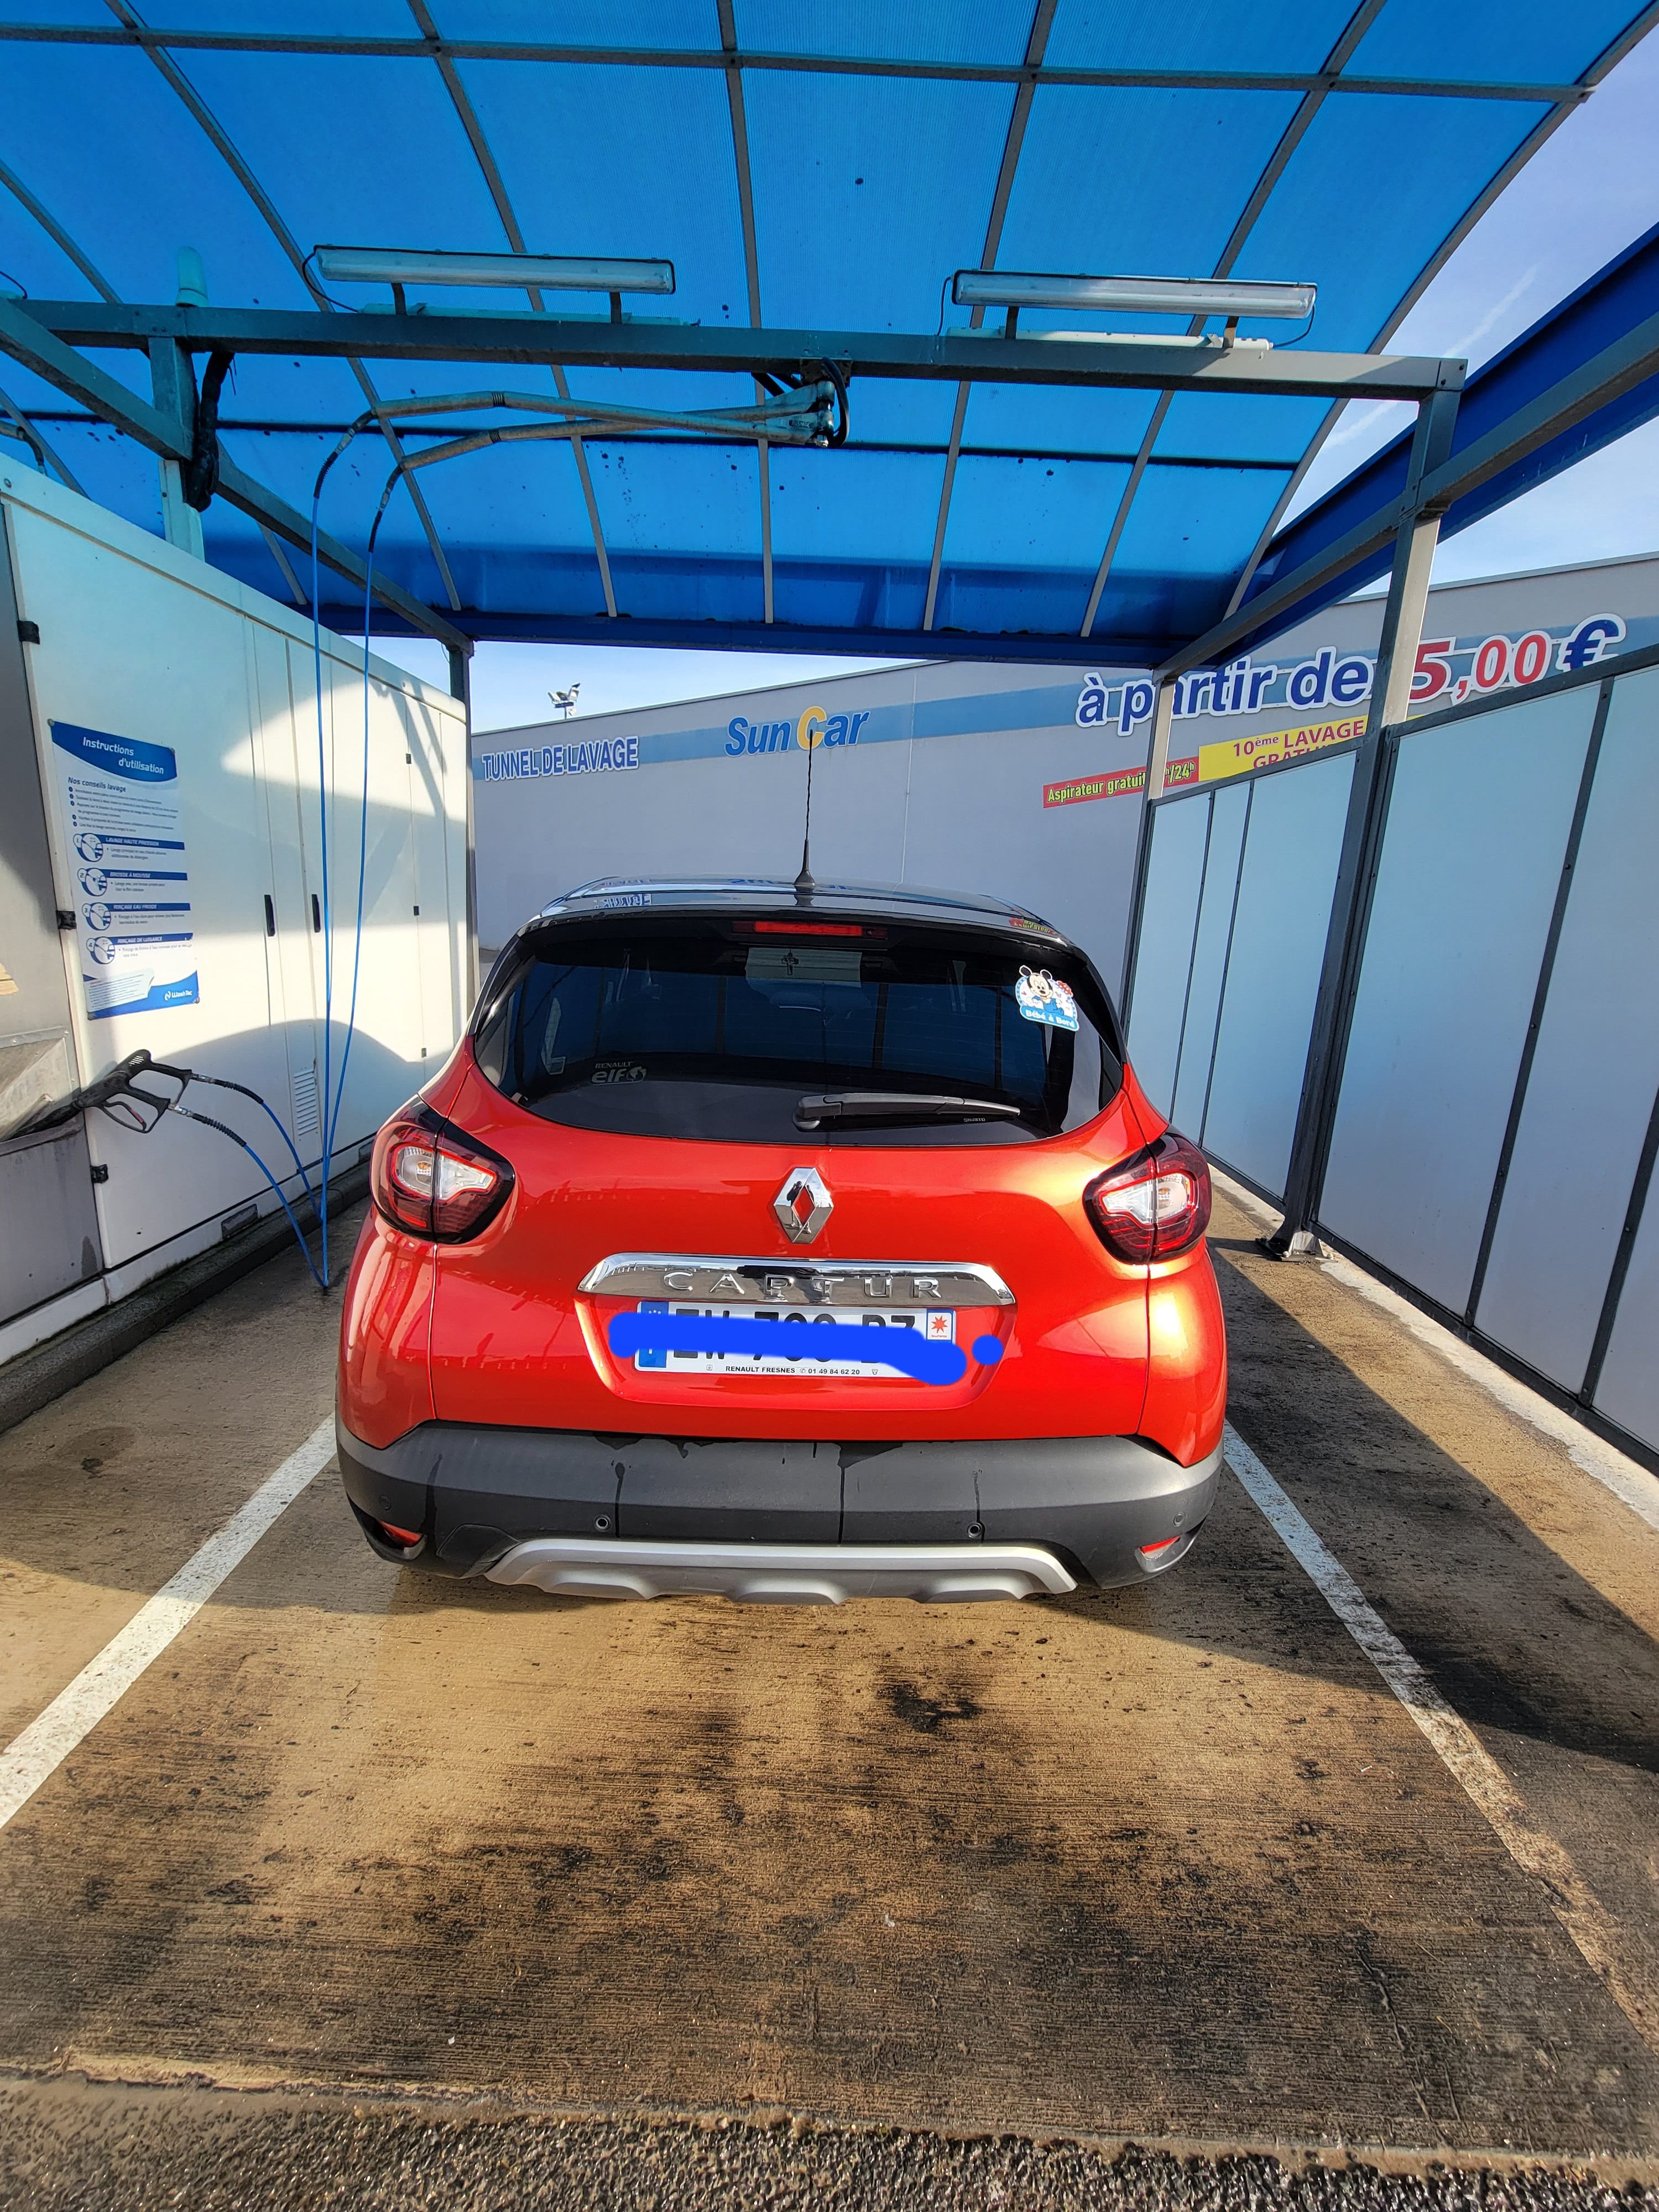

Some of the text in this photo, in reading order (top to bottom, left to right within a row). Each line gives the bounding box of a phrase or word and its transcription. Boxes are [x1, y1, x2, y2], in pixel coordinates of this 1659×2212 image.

[1081, 676, 1105, 723] à
[1291, 652, 1369, 706] de
[1408, 634, 1547, 700] 5,00
[1564, 619, 1619, 671] €
[82, 737, 134, 757] Instructions
[1233, 720, 1365, 757] 10ème LAVAGE
[118, 758, 164, 774] d'utilisation
[482, 737, 638, 779] TUNNEL DE LAVAGE
[67, 776, 126, 793] Nos conseils lavage
[1047, 781, 1104, 803] Aspirateur
[1025, 1009, 1046, 1020] Bébé
[1055, 1016, 1076, 1028] Bord
[592, 1068, 627, 1083] elf
[664, 1271, 942, 1300] CAPTUR
